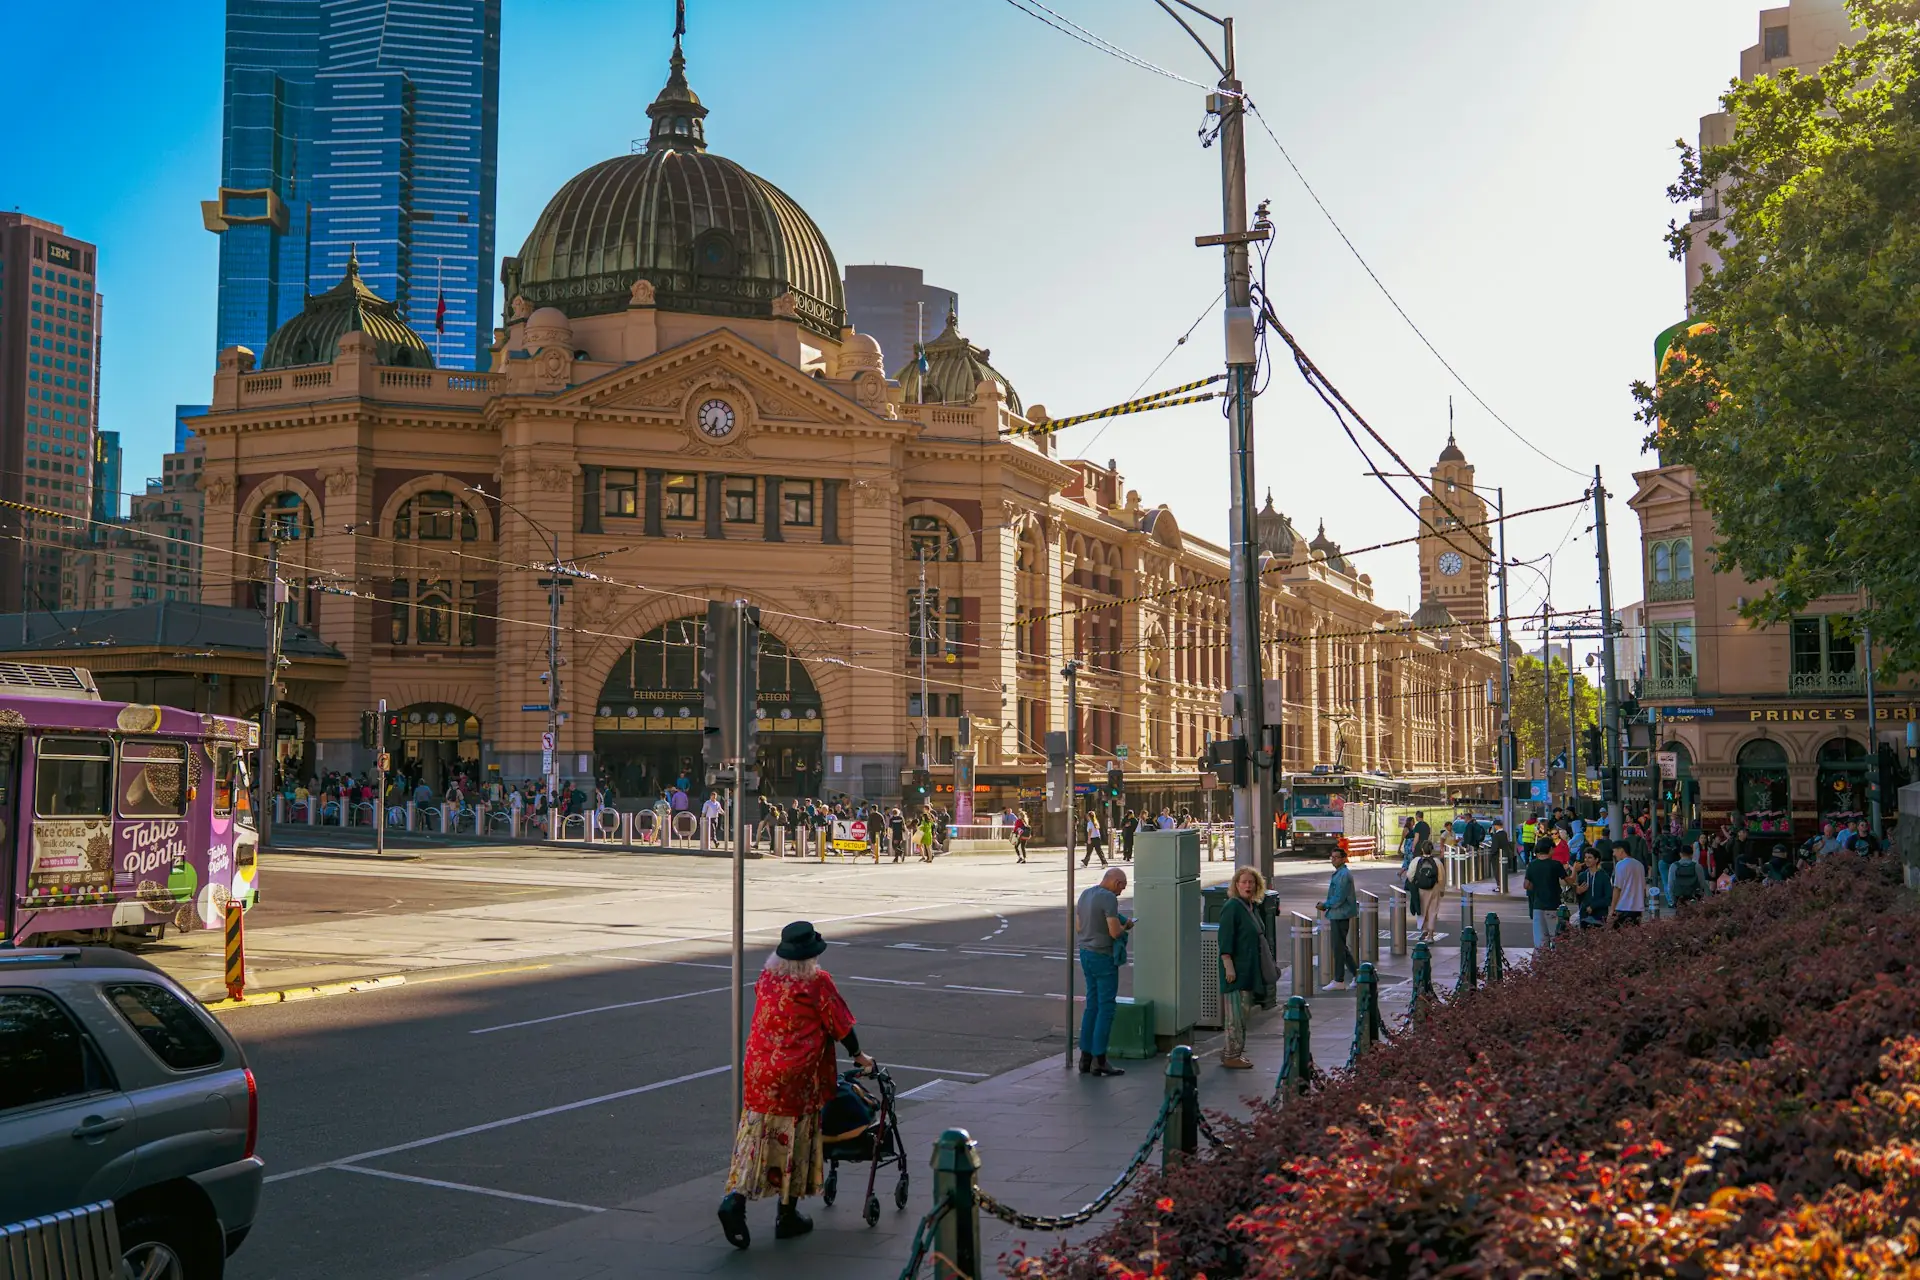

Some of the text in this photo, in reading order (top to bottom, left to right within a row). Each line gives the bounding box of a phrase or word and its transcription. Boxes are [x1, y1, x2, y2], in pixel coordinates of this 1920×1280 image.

[50, 245, 70, 260] IBM
[633, 690, 790, 701] FLINDERS ATION
[1750, 709, 1856, 721] PRINCE'S
[122, 819, 179, 851] Table
[43, 839, 76, 848] milk choc
[123, 839, 187, 878] Plenty
[206, 843, 228, 861] Table
